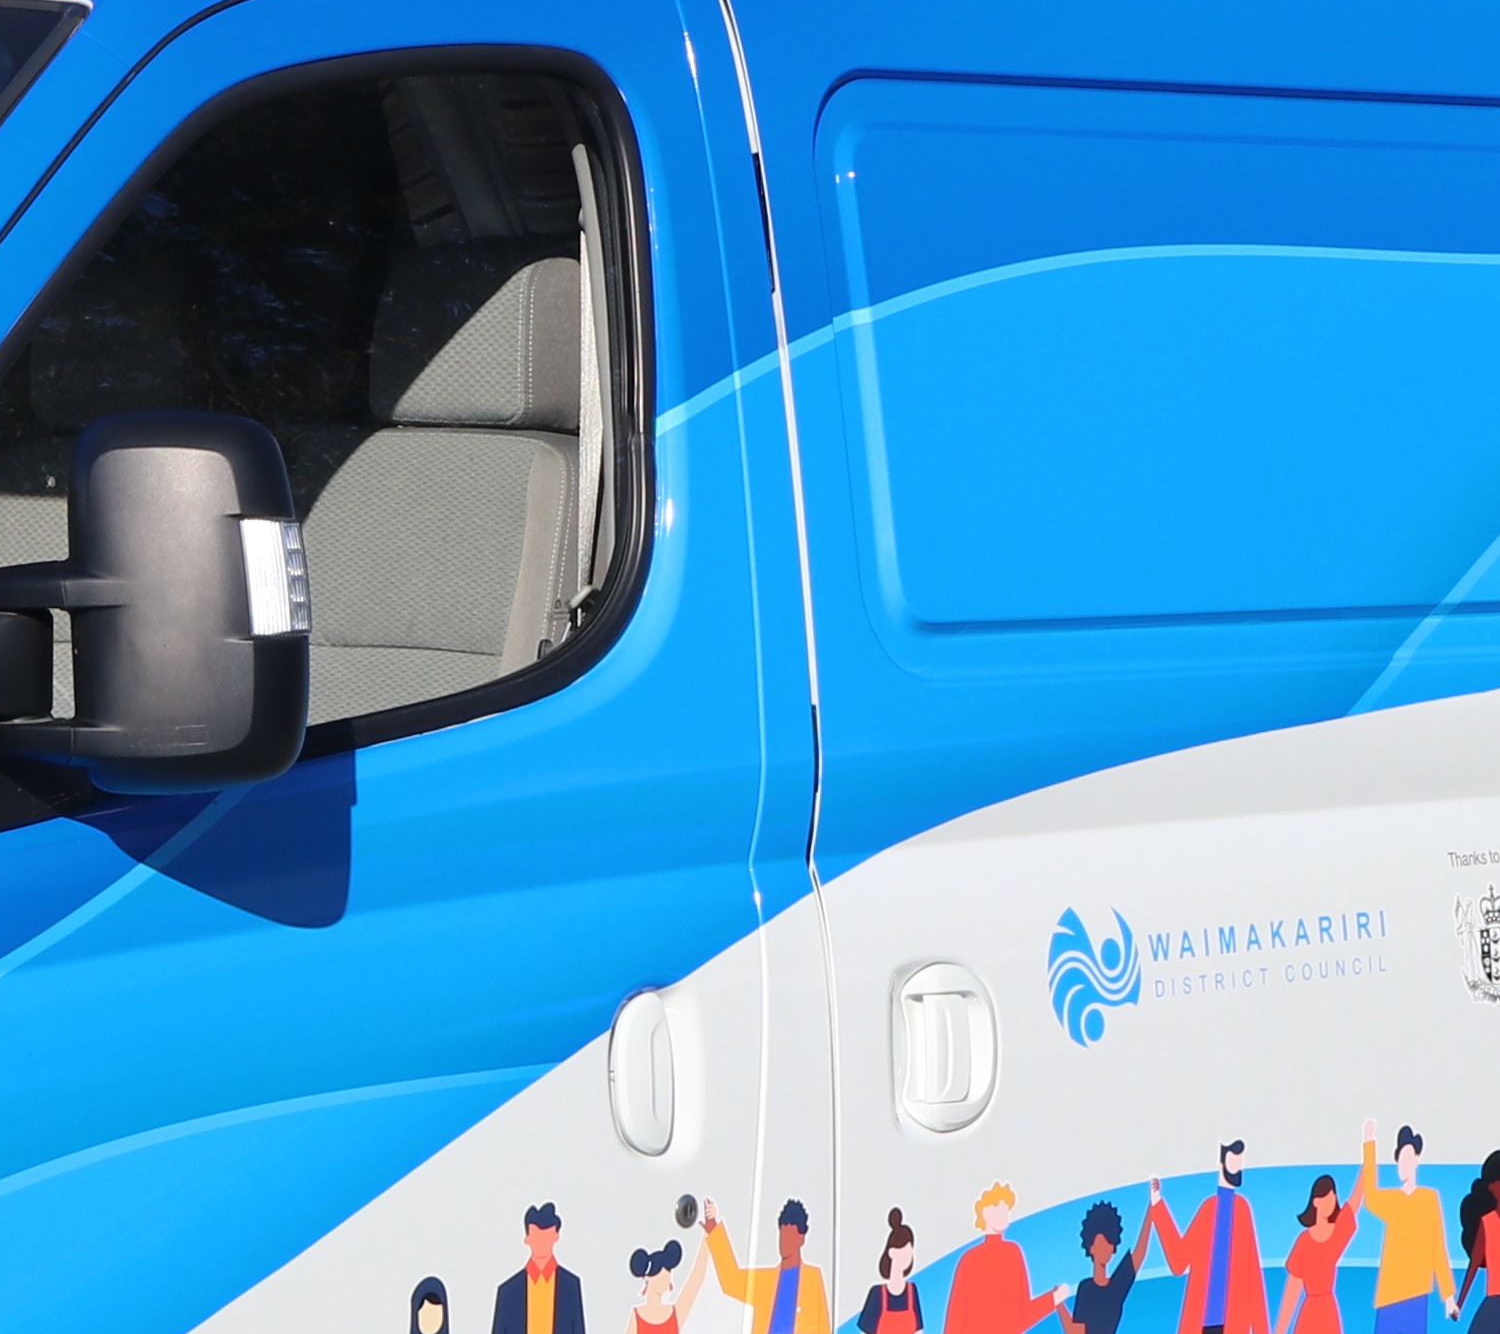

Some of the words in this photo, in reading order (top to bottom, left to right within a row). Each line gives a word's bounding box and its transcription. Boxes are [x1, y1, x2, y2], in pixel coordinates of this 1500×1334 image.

[1447, 851, 1487, 868] Thanks
[1489, 849, 1500, 865] to
[1148, 909, 1388, 963] WAIMAKARIRI
[1154, 966, 1270, 999] DISTRICT
[1284, 953, 1388, 984] COUNCIL
